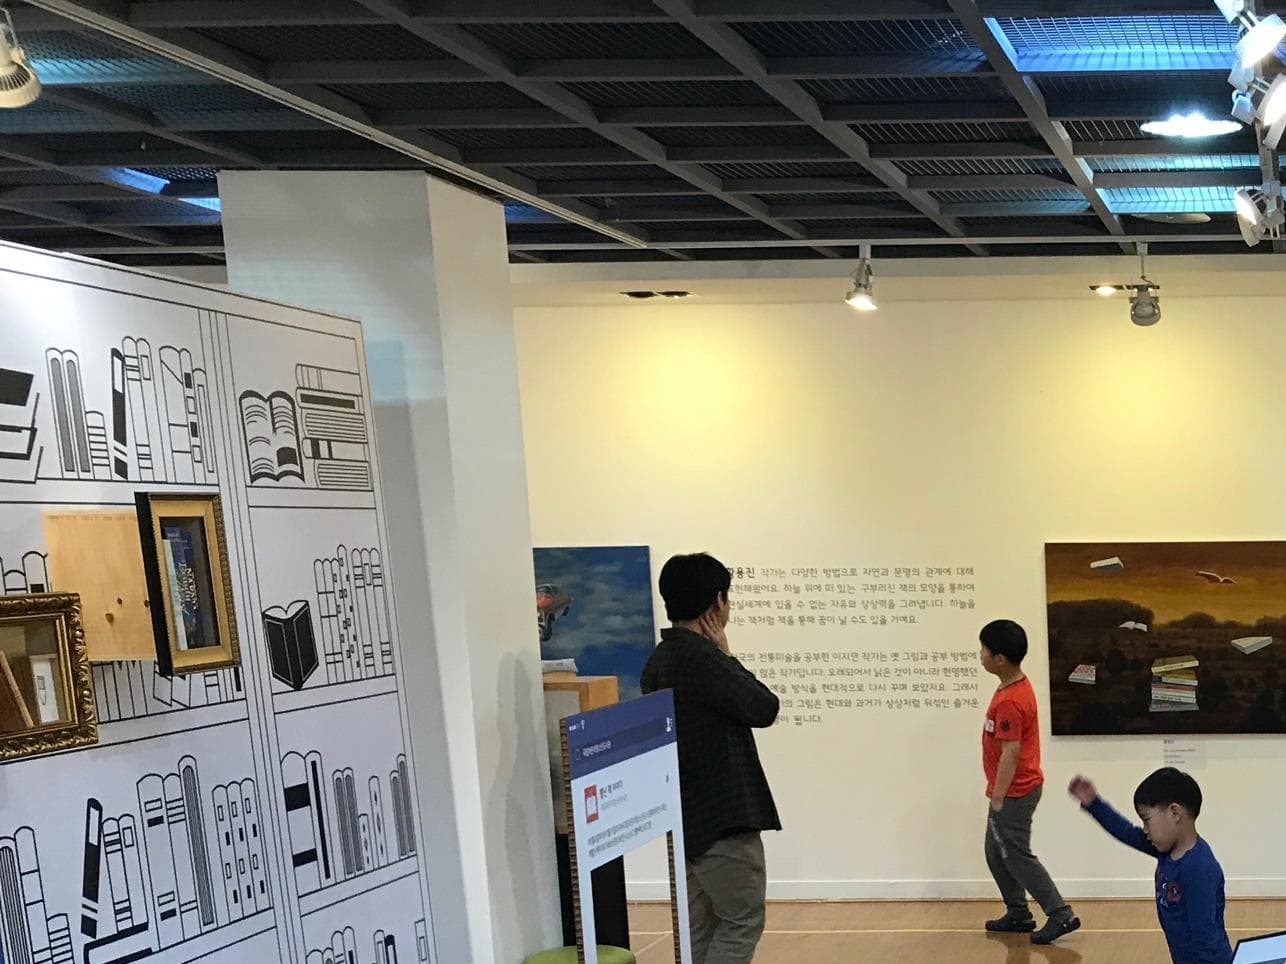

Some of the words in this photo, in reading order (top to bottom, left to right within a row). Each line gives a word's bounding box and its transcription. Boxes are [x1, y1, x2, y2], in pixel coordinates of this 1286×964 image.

[760, 567, 786, 579] 작가는
[791, 567, 818, 579] 다양한
[823, 567, 857, 579] 방법으로
[863, 568, 889, 578] 자연과
[895, 568, 920, 578] 문명의
[926, 568, 951, 578] 관계에
[957, 568, 974, 578] 대해
[784, 584, 801, 594] 하늘
[805, 584, 822, 594] 위에
[837, 584, 856, 594] 있는
[861, 584, 896, 593] 구부러진
[899, 584, 916, 593] 책의
[920, 584, 945, 593] 모양을
[775, 600, 792, 609] 있을
[796, 600, 805, 609] 수
[809, 600, 826, 609] 없는
[830, 600, 856, 609] 자유와
[860, 599, 895, 609] 상상력을
[950, 599, 975, 609] 하늘을
[748, 616, 775, 626] 책처럼
[777, 616, 794, 626] 책을
[798, 616, 815, 626] 통해
[850, 615, 867, 625] 수도
[870, 615, 887, 625] 있을
[758, 653, 801, 662] 전통미술을
[804, 653, 830, 662] 공부한
[862, 652, 887, 662] 작가는
[902, 652, 928, 662] 그림과
[931, 652, 947, 662] 공부
[950, 652, 977, 662] 방법에
[760, 669, 776, 678] 많은
[894, 668, 911, 677] 것이
[914, 667, 940, 676] 아니라
[791, 684, 817, 694] 방식을
[822, 683, 865, 693] 현대적으로
[868, 683, 886, 692] 다시
[953, 683, 978, 691] 그래서
[797, 699, 821, 708] 그림은
[856, 699, 882, 709] 과거가
[953, 699, 979, 709] 즐거운
